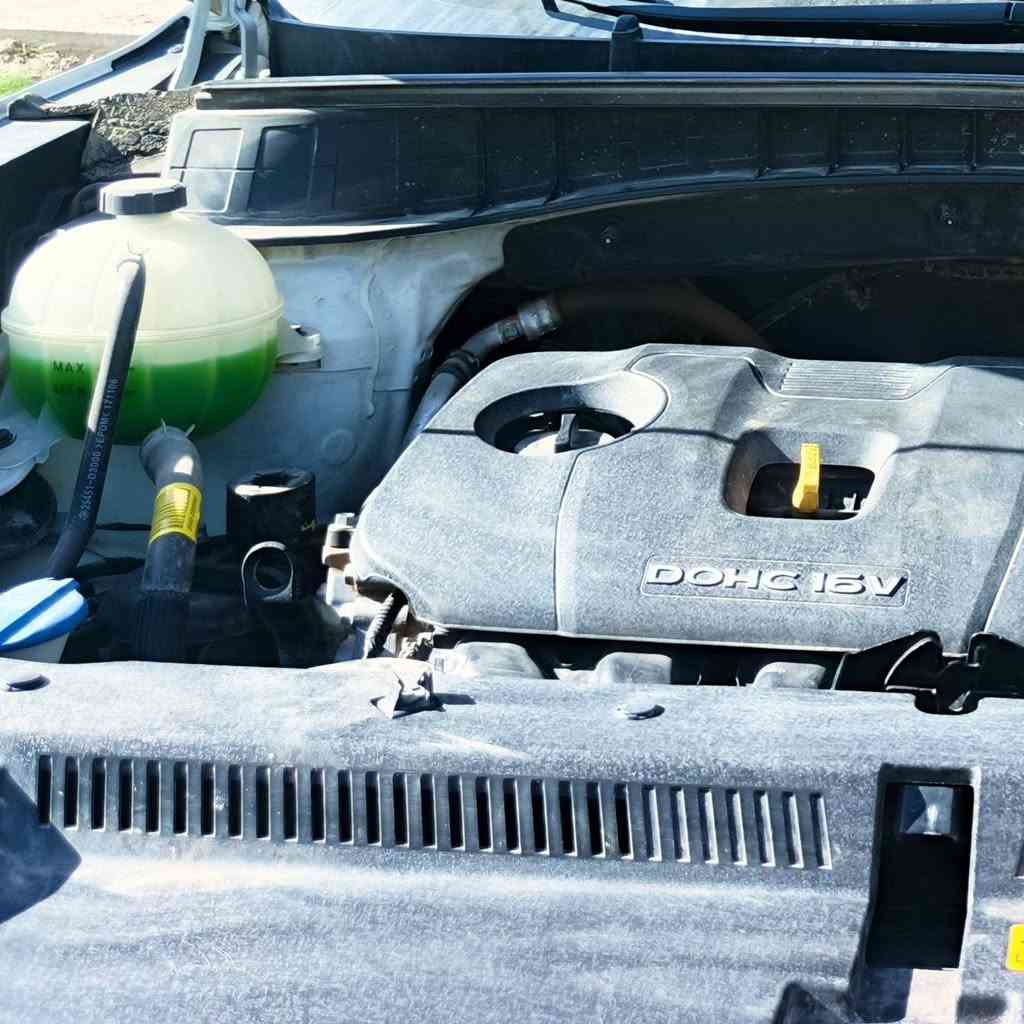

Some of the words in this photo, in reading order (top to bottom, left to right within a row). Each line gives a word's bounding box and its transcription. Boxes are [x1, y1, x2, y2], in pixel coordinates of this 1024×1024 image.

[53, 361, 84, 375] MAX
[647, 564, 800, 592] DOHC
[814, 573, 907, 598] 16V
